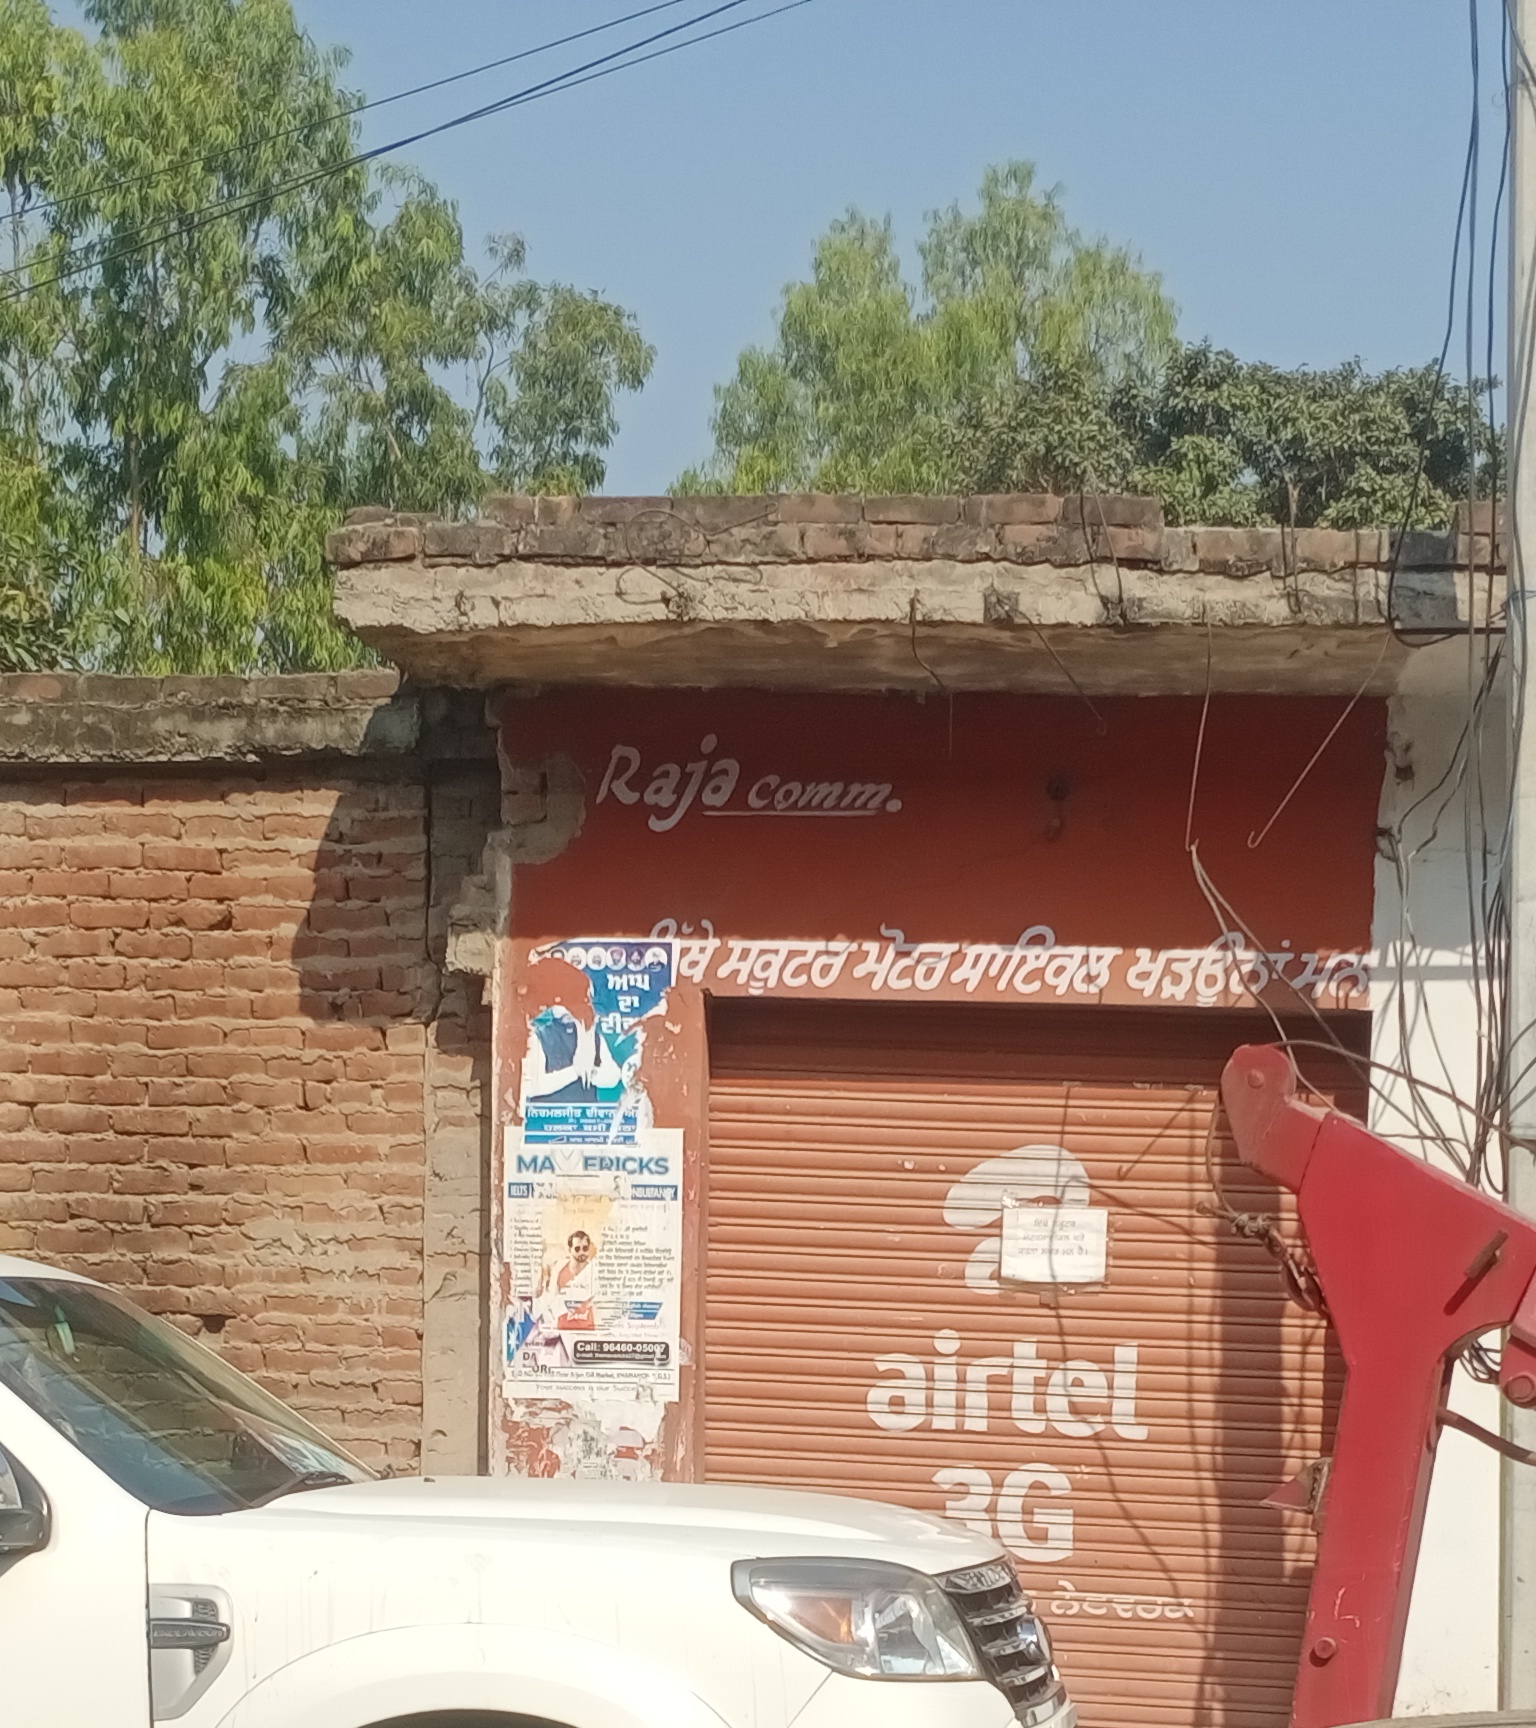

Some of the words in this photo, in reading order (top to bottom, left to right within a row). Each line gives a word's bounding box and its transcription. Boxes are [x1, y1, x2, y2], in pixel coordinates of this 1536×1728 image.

[595, 733, 741, 832] Raja
[747, 773, 903, 814] comm.
[867, 1328, 1149, 1441] airtel
[932, 1462, 1076, 1563] 3G
